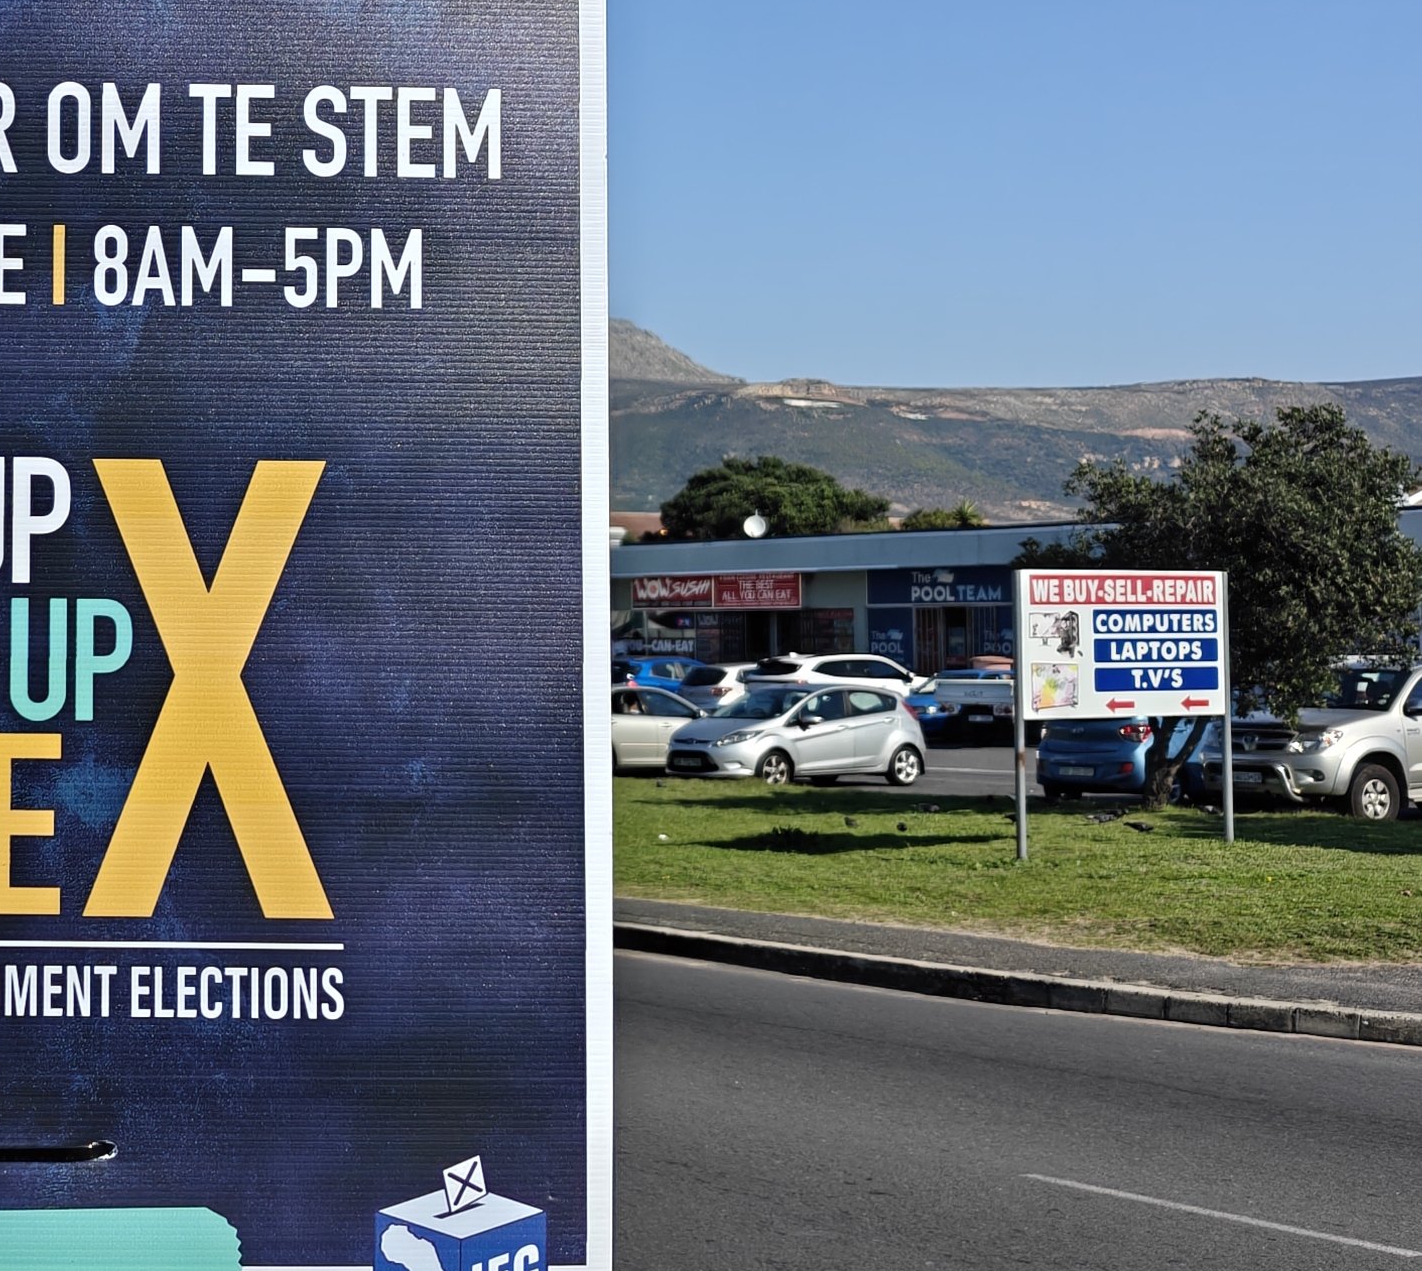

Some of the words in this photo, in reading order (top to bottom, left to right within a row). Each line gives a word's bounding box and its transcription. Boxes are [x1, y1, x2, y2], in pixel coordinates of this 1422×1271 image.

[46, 81, 163, 176] OM
[188, 84, 276, 178] TE
[301, 86, 503, 181] STEM
[93, 225, 424, 311] 8AM-5PM
[755, 579, 775, 589] BEST
[911, 572, 932, 584] The
[634, 579, 670, 600] WOW
[669, 580, 711, 598] SUSHI
[721, 590, 738, 600] ALL
[740, 590, 756, 600] YOU
[757, 590, 773, 600] CAN
[775, 589, 792, 599] EAT
[910, 585, 956, 602] POOL
[956, 585, 1002, 601] TEAM
[1032, 578, 1061, 603] WE
[1095, 613, 1216, 633] COMPUTERS
[871, 642, 904, 654] POOL
[1110, 641, 1203, 661] LAPTOPS
[9, 597, 133, 722] UP
[1131, 669, 1183, 689] T.V'S
[131, 966, 345, 1020] ELECTIONS
